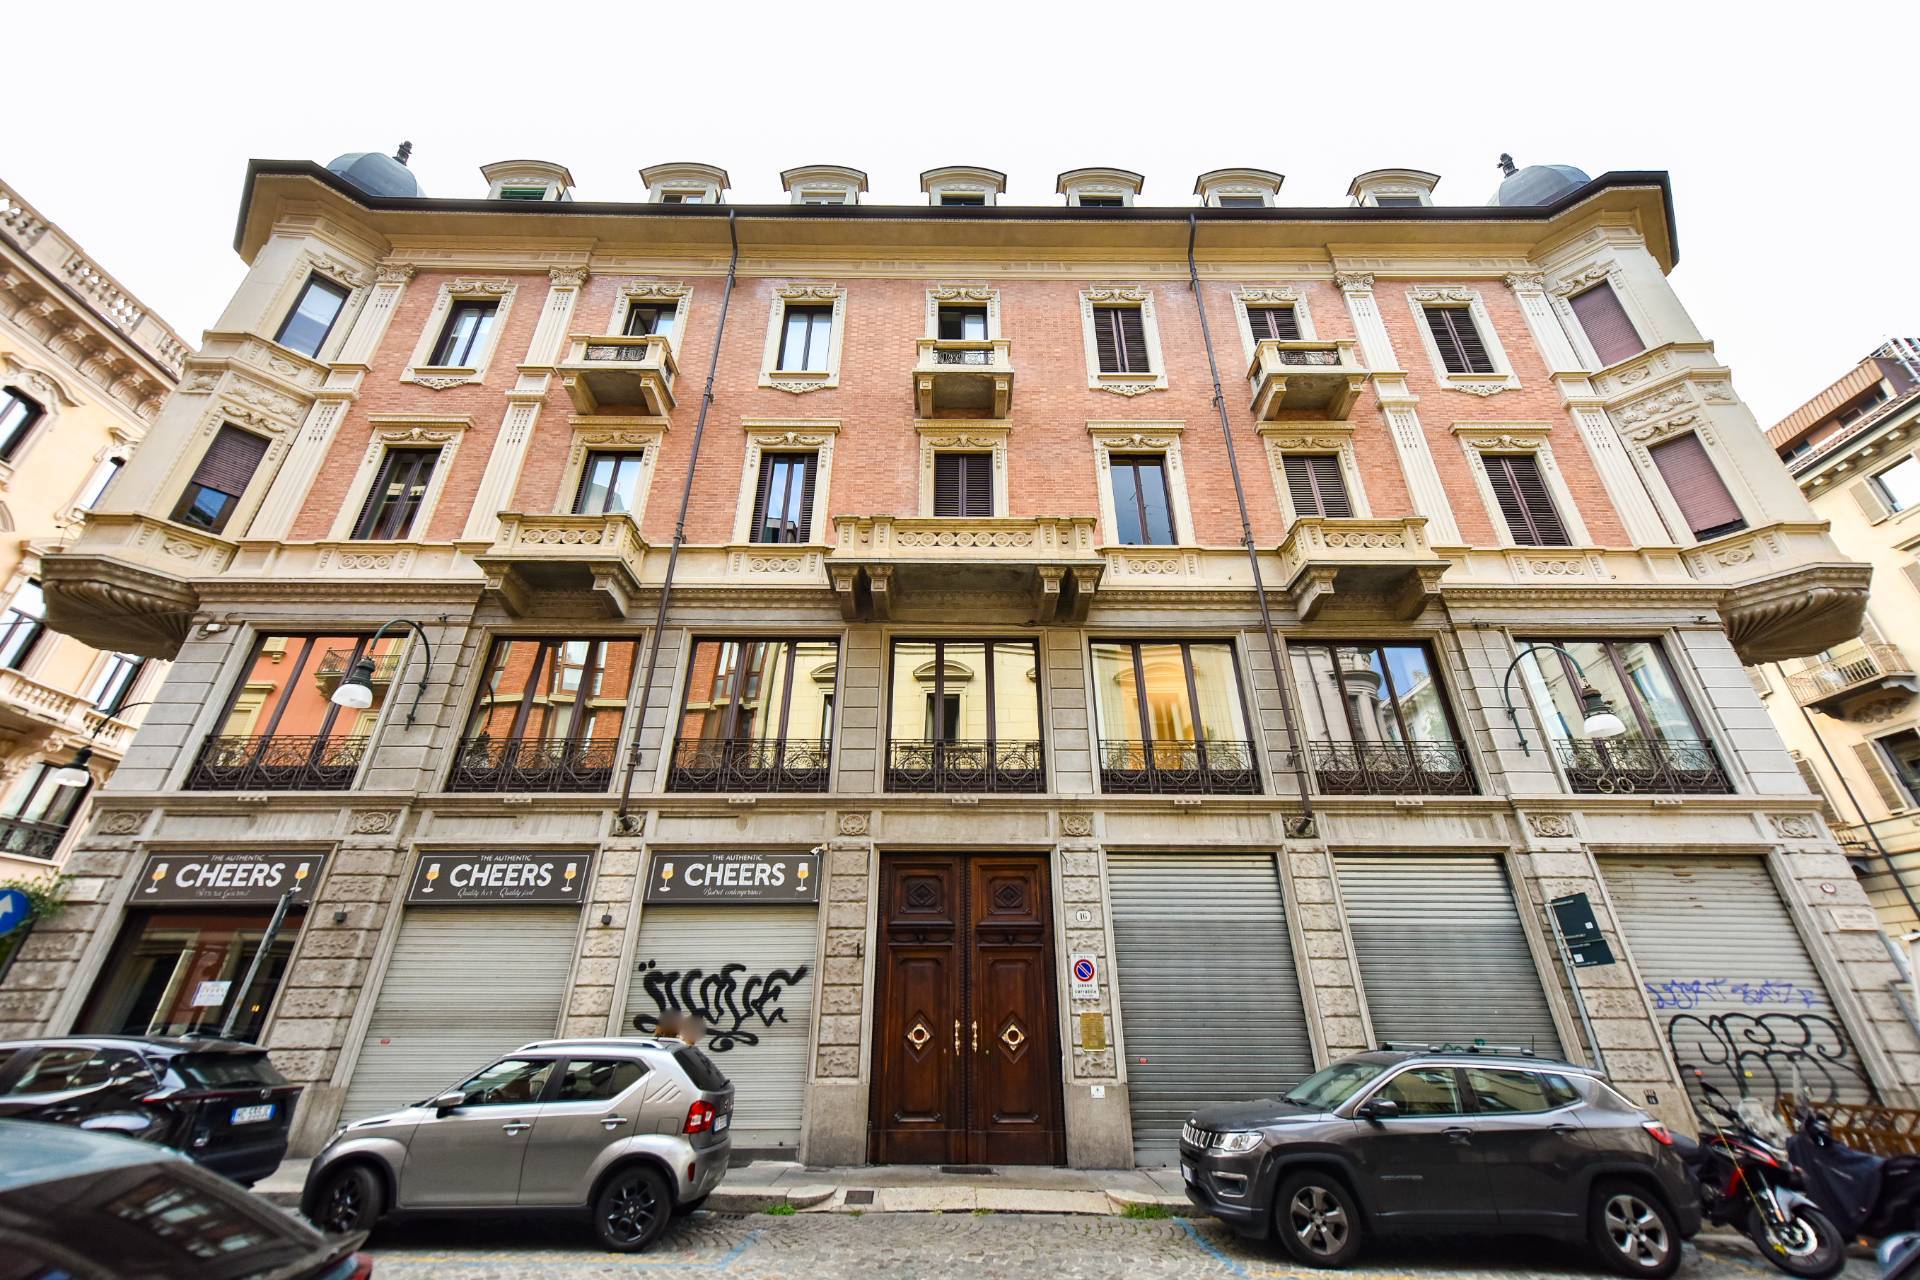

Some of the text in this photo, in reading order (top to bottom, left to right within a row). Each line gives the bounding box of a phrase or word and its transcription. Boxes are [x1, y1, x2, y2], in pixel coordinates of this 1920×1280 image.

[210, 854, 265, 862] THE AUTHENTIC
[494, 854, 532, 862] AUTHENTIC
[175, 862, 286, 888] CHEERS
[449, 862, 554, 888] CHEERS
[684, 862, 786, 887] CHEERS
